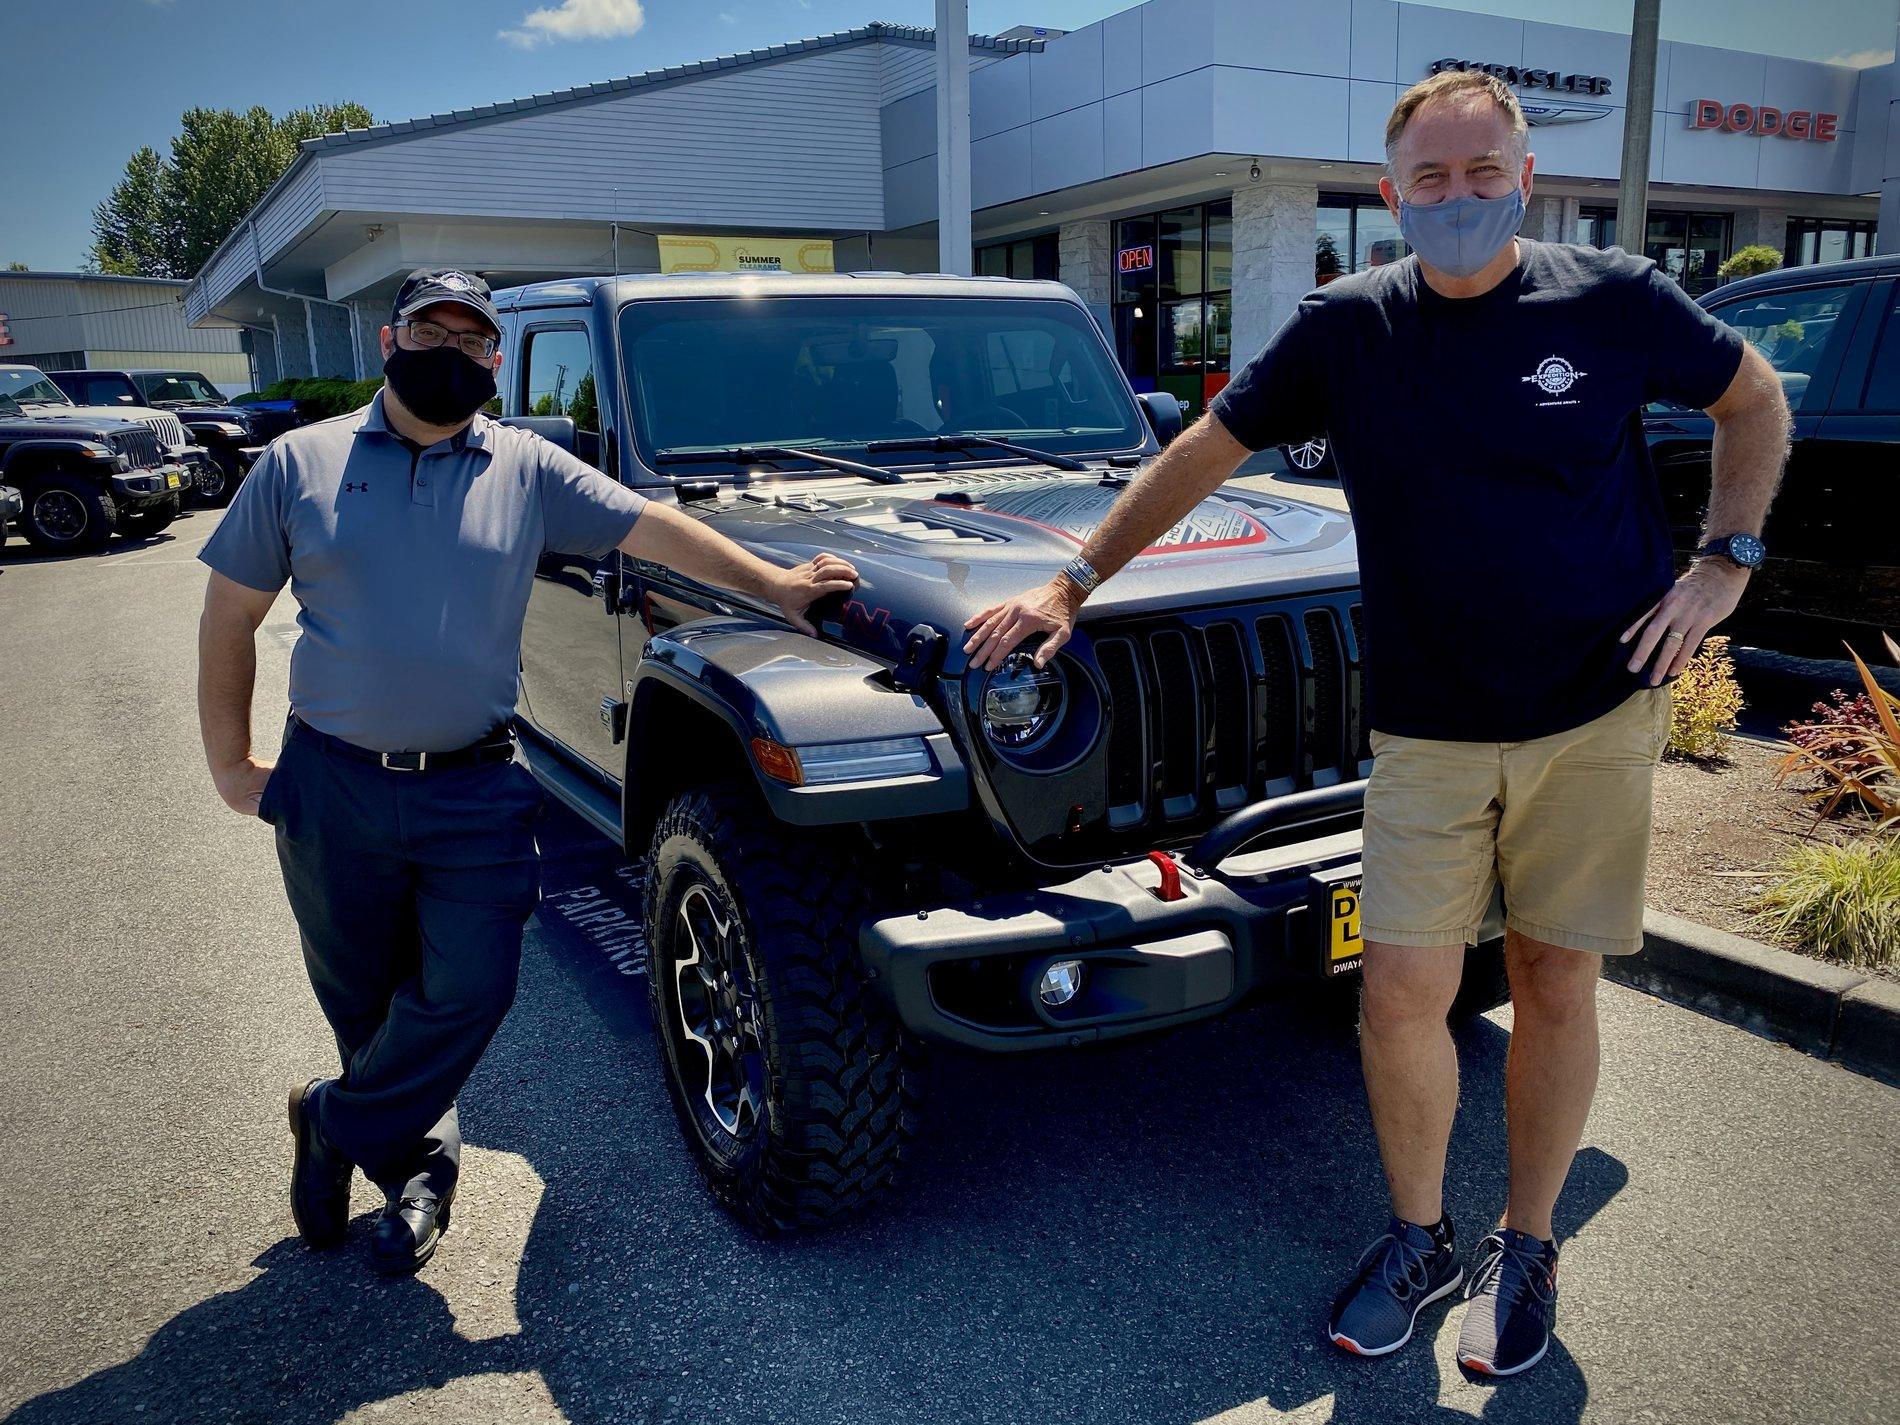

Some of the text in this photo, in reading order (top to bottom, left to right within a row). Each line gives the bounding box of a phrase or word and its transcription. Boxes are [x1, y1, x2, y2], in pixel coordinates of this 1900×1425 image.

[1433, 57, 1613, 95] CHRYSLER
[1690, 99, 1839, 141] DODGE
[738, 256, 781, 264] SUMMER
[739, 263, 782, 271] CLEARANCE
[1120, 248, 1151, 270] OPEN
[1531, 372, 1579, 383] EXPEDITION
